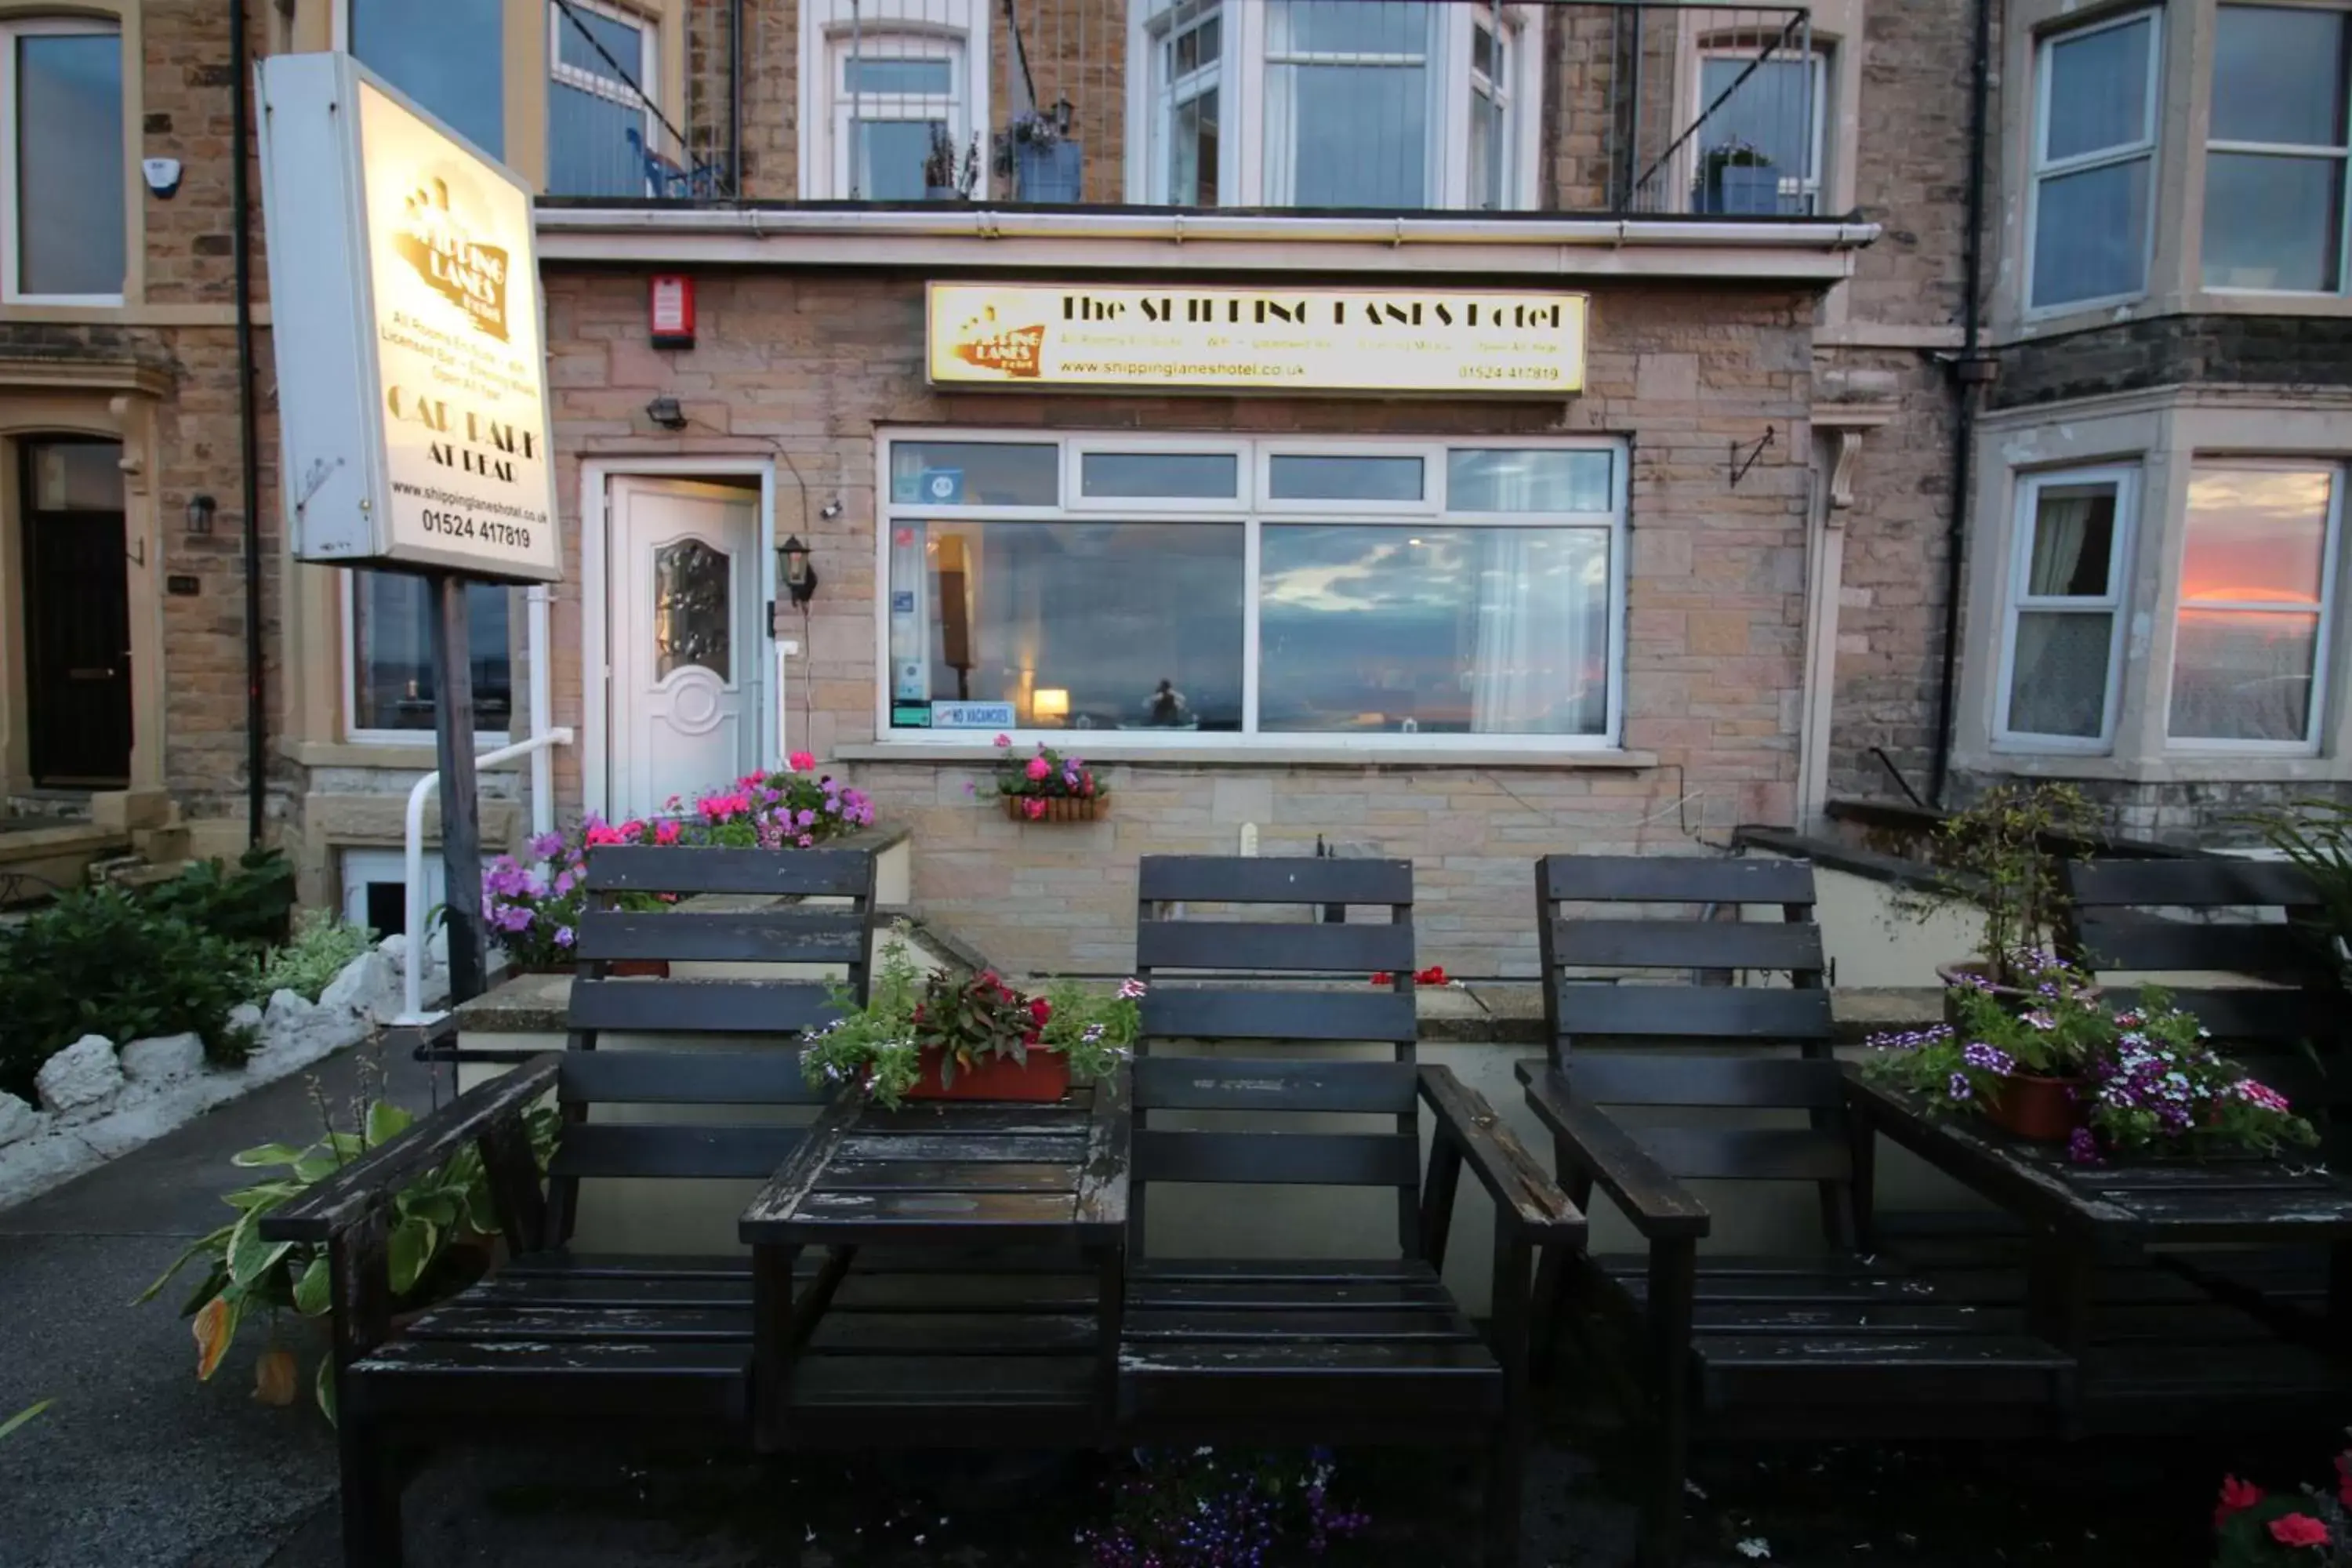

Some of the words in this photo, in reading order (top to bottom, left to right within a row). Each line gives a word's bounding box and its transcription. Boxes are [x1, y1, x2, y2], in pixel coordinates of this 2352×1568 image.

[430, 249, 496, 306] LANES
[1062, 296, 1127, 321] The
[976, 345, 1031, 361] LANES
[1459, 366, 1502, 379] 01524
[387, 385, 455, 436] CAR
[465, 411, 543, 463] PARK
[426, 440, 455, 467] AT
[463, 448, 519, 486] REAR
[392, 481, 548, 523] www.shippinglaneshotel.co.uk
[422, 509, 474, 539] 01524
[479, 521, 531, 549] 417819
[953, 708, 964, 723] NO
[967, 708, 1008, 724] VACANCIES
